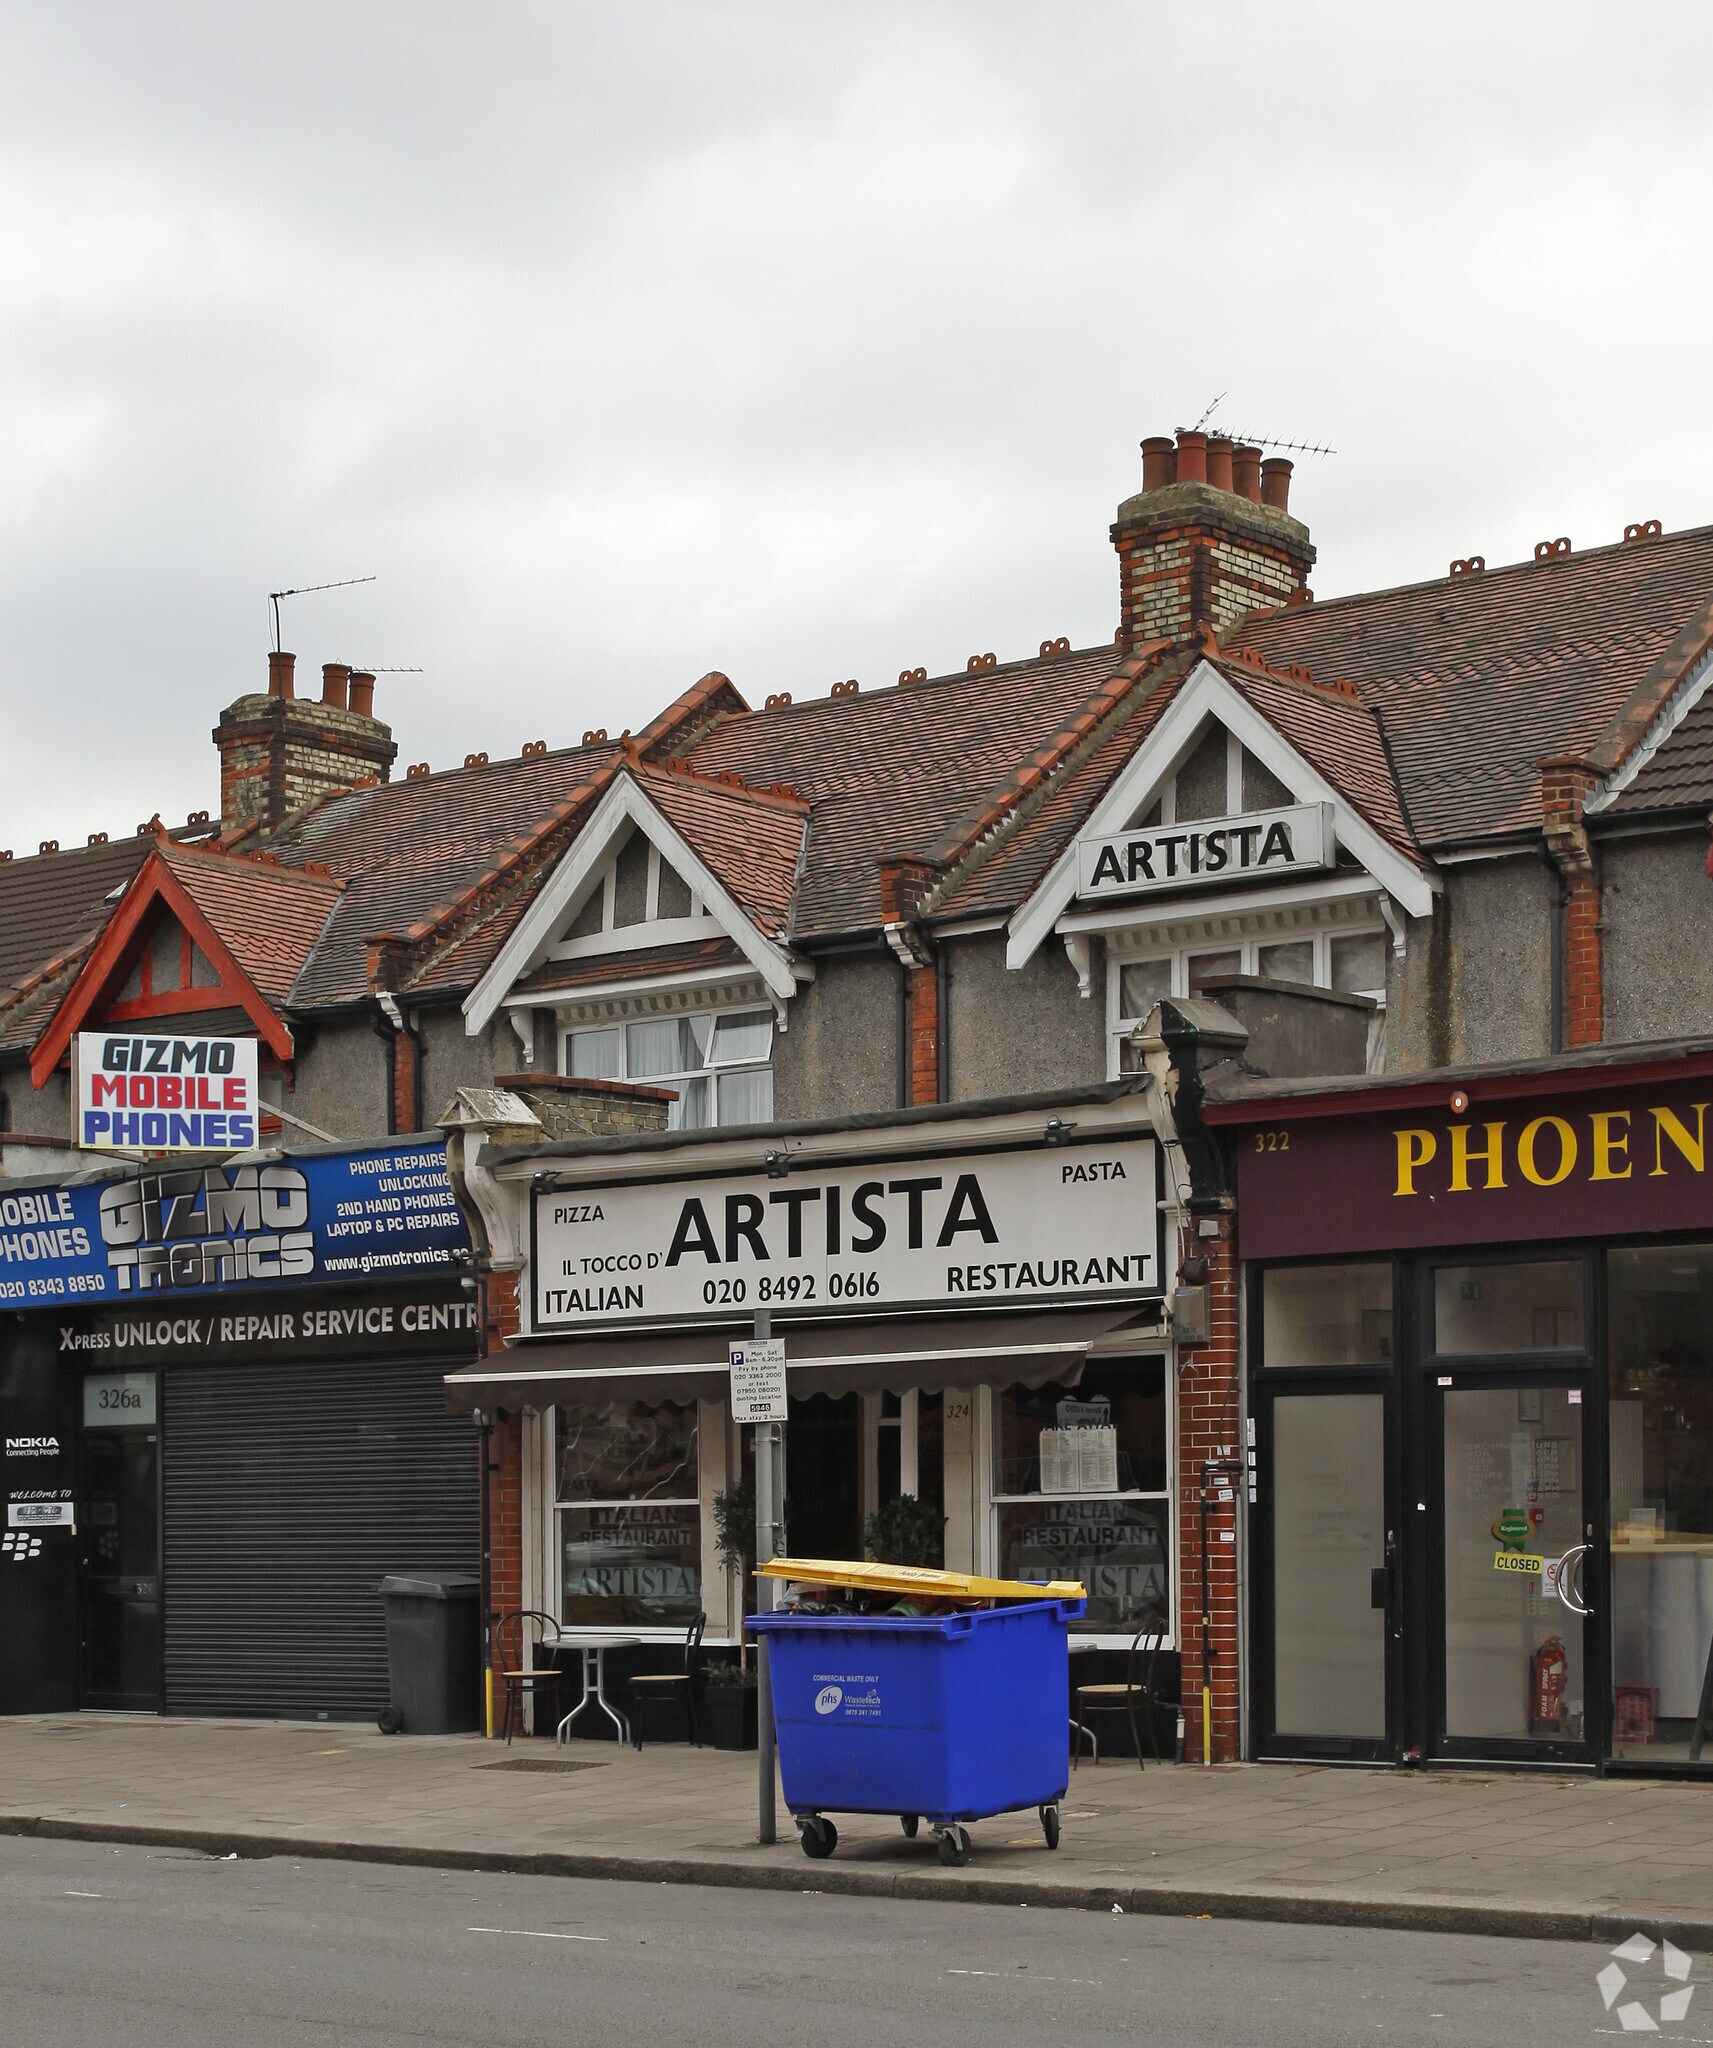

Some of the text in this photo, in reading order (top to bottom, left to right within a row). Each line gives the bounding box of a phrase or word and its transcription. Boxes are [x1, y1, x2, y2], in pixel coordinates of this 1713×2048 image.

[1090, 822, 1295, 886] ARTISTA
[102, 1038, 236, 1074] GIZMO
[91, 1074, 247, 1110] MOBILE
[84, 1111, 254, 1148] PHONES
[1254, 1132, 1290, 1152] 322
[1393, 1103, 1712, 1196] PHOEN
[349, 1152, 447, 1176] PHONE REPAIRS
[1062, 1161, 1127, 1184] PASTA
[378, 1172, 451, 1193] UNLOCKING
[0, 1192, 75, 1228] OBILE
[336, 1192, 456, 1217] 2ND HAND PHONES
[554, 1205, 605, 1225] PIZZA
[326, 1211, 460, 1237] LAPTOP & PC REPAIRS
[665, 1173, 999, 1267] ARTISTA
[563, 1259, 576, 1276] IL
[580, 1253, 642, 1275] TOCCO
[947, 1254, 1152, 1293] RESTAURANT
[0, 1273, 106, 1299] 020 8343 8850
[703, 1271, 880, 1305] 020 8492 0616
[546, 1284, 644, 1314] ITALIAN
[114, 1318, 202, 1347] UNLOCK
[205, 1317, 215, 1346] /
[220, 1313, 296, 1342] REPAIR
[302, 1306, 394, 1338] SERVICE
[401, 1302, 477, 1332] CENTR
[98, 1388, 142, 1409] 326a
[946, 1403, 970, 1419] 324
[6, 1437, 59, 1448] NOKIA
[6, 1447, 60, 1457] Connecting People
[9, 1489, 72, 1499] WELCOME TO
[595, 1508, 679, 1522] ITALIAN
[1045, 1501, 1128, 1520] ITALIAN
[580, 1529, 691, 1545] RESTAURANT
[1022, 1527, 1158, 1545] RESTAURANT
[1497, 1556, 1540, 1571] CLOSED
[576, 1568, 692, 1595] ARTISTA
[812, 1674, 879, 1683] COMMERCIAL WASTE ONLY
[821, 1693, 837, 1705] phs
[844, 1695, 880, 1705] Wastetech
